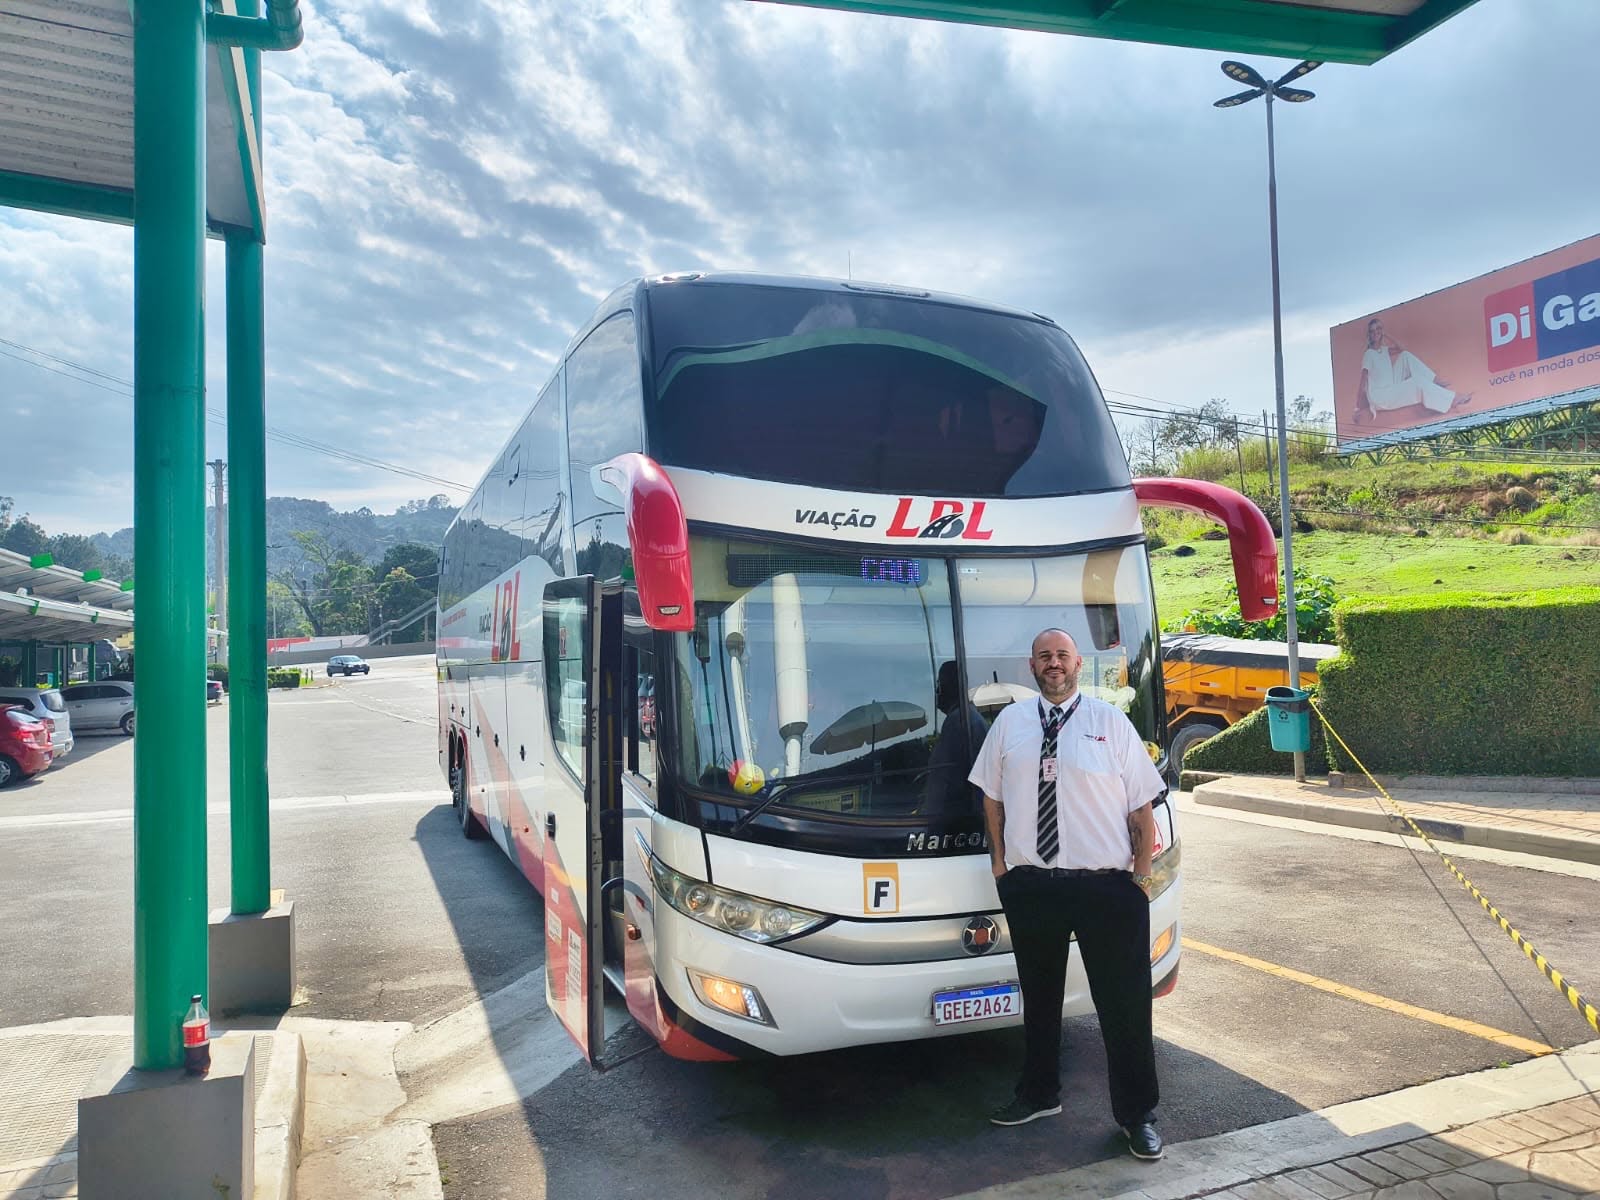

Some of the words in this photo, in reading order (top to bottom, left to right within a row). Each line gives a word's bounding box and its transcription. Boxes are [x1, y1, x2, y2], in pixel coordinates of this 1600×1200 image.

[1490, 305, 1531, 348] Di
[1542, 292, 1600, 331] Ga
[1489, 371, 1516, 386] você
[1519, 368, 1534, 379] na
[1537, 358, 1574, 375] moda
[1577, 351, 1600, 364] dos
[795, 509, 876, 531] VIAÇÃO
[886, 497, 994, 540] LBL
[874, 881, 889, 907] F
[943, 995, 1011, 1021] GEE2A62
